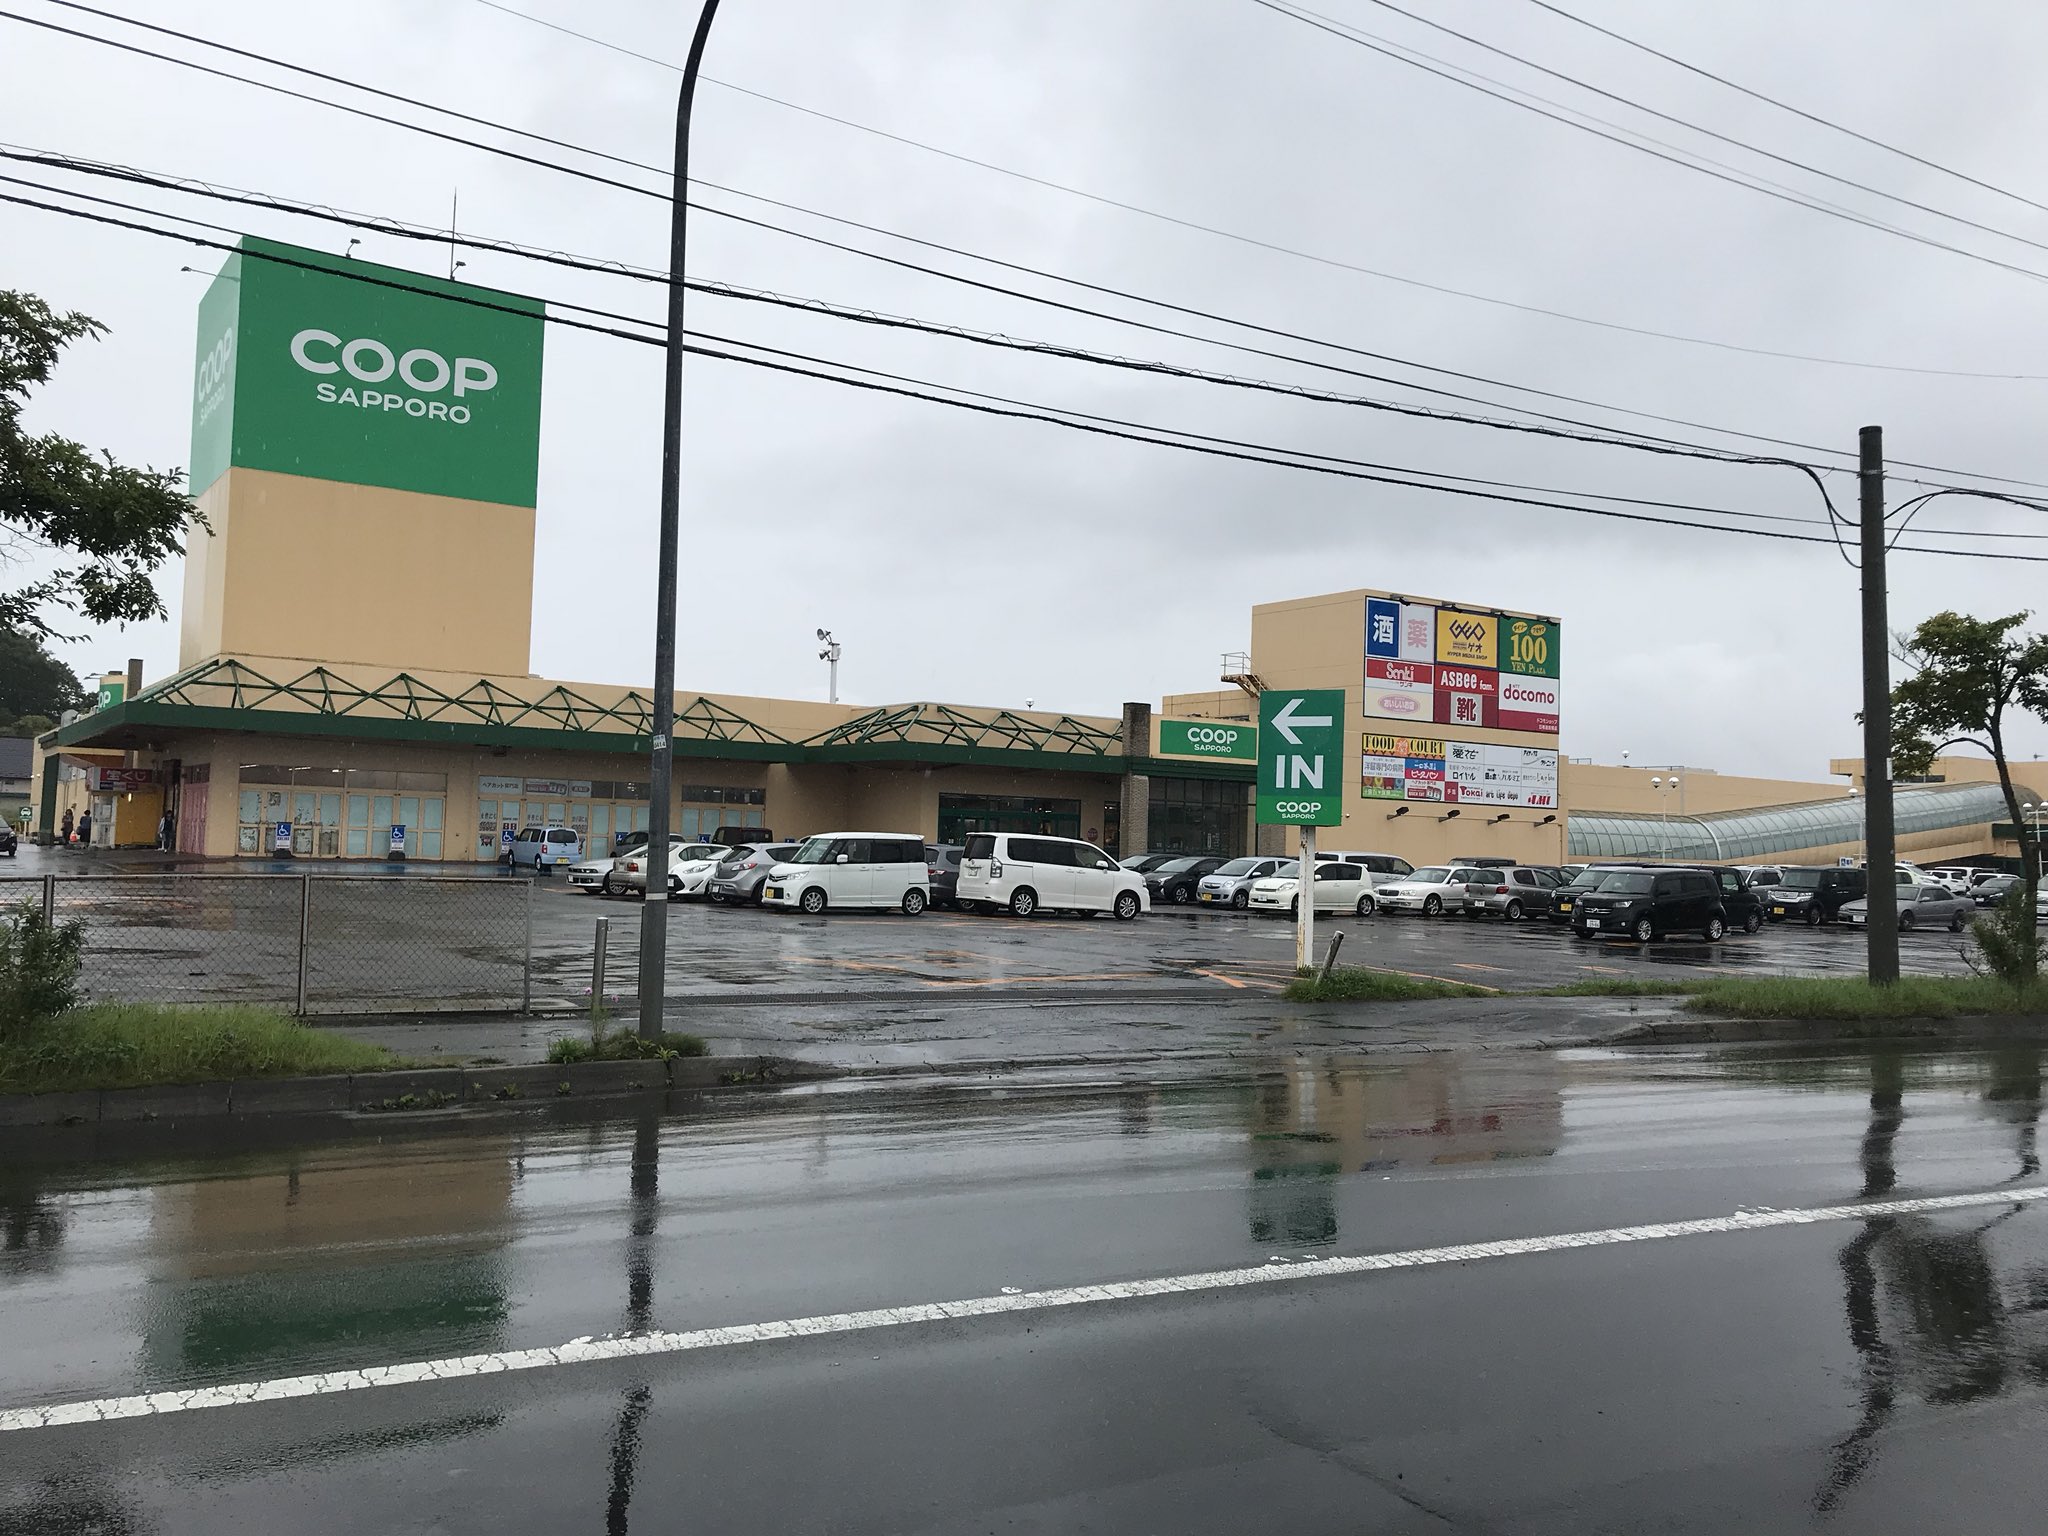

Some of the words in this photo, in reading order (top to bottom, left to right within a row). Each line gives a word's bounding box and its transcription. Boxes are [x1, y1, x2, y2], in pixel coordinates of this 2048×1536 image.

[198, 327, 233, 399] COOP
[290, 328, 498, 398] COOP
[316, 382, 471, 424] SAPPORO
[1372, 613, 1394, 645] 酒
[1407, 618, 1428, 648] 薬
[1448, 619, 1486, 642] GEO
[1467, 642, 1483, 653] ゲオ
[1510, 633, 1547, 665] 100
[1511, 661, 1526, 672] YEN
[1440, 670, 1477, 689] ASBee
[1503, 684, 1555, 704] docomo
[1456, 697, 1477, 722] 靴
[1187, 727, 1238, 745] COOP
[1365, 735, 1395, 750] FOOD
[1410, 739, 1445, 753] COURT
[1194, 744, 1232, 753] SAPPORO
[1275, 754, 1324, 789] IN
[1452, 771, 1477, 781] ロイヤル
[1276, 801, 1322, 813] COOP
